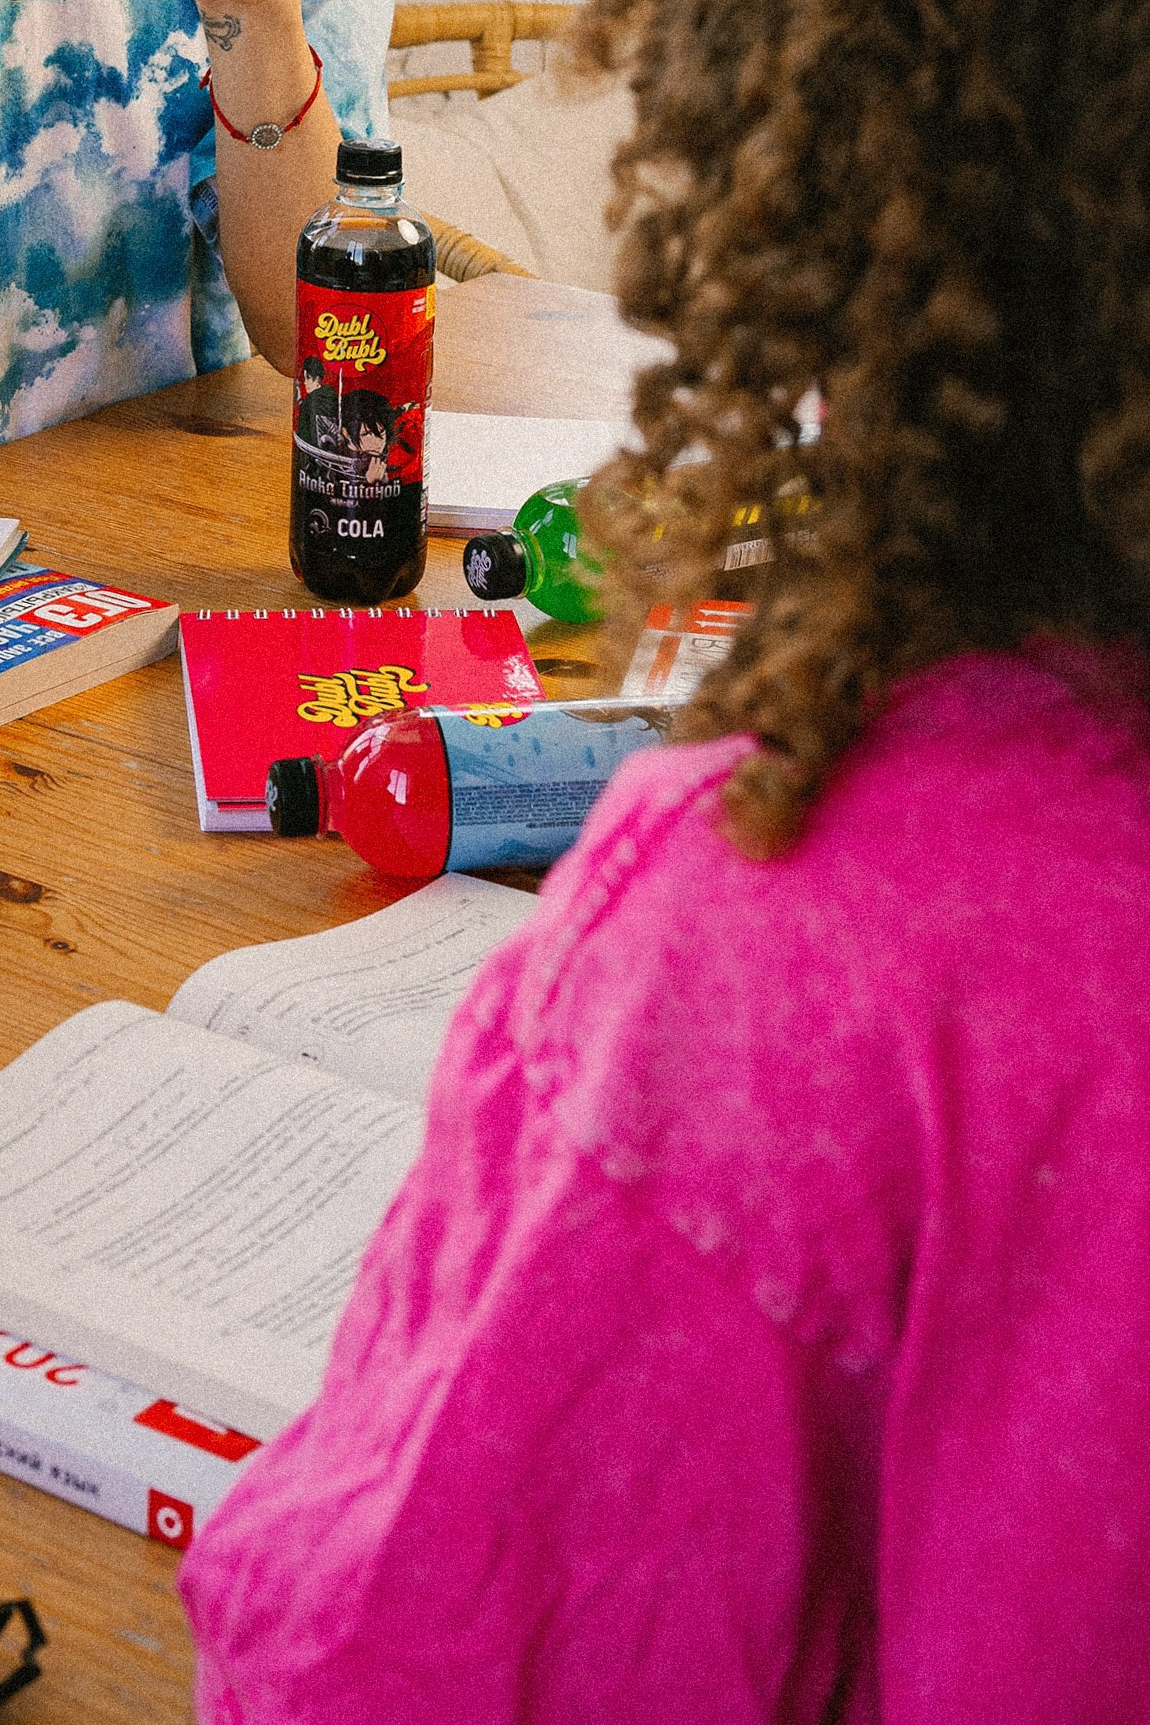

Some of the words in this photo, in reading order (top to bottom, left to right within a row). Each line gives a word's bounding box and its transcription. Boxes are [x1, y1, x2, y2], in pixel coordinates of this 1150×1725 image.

[314, 312, 371, 339] Dubl
[322, 335, 387, 372] Bubl
[337, 517, 385, 539] COLA
[34, 590, 152, 629] ОГЭ
[33, 629, 67, 648] ВСЕ
